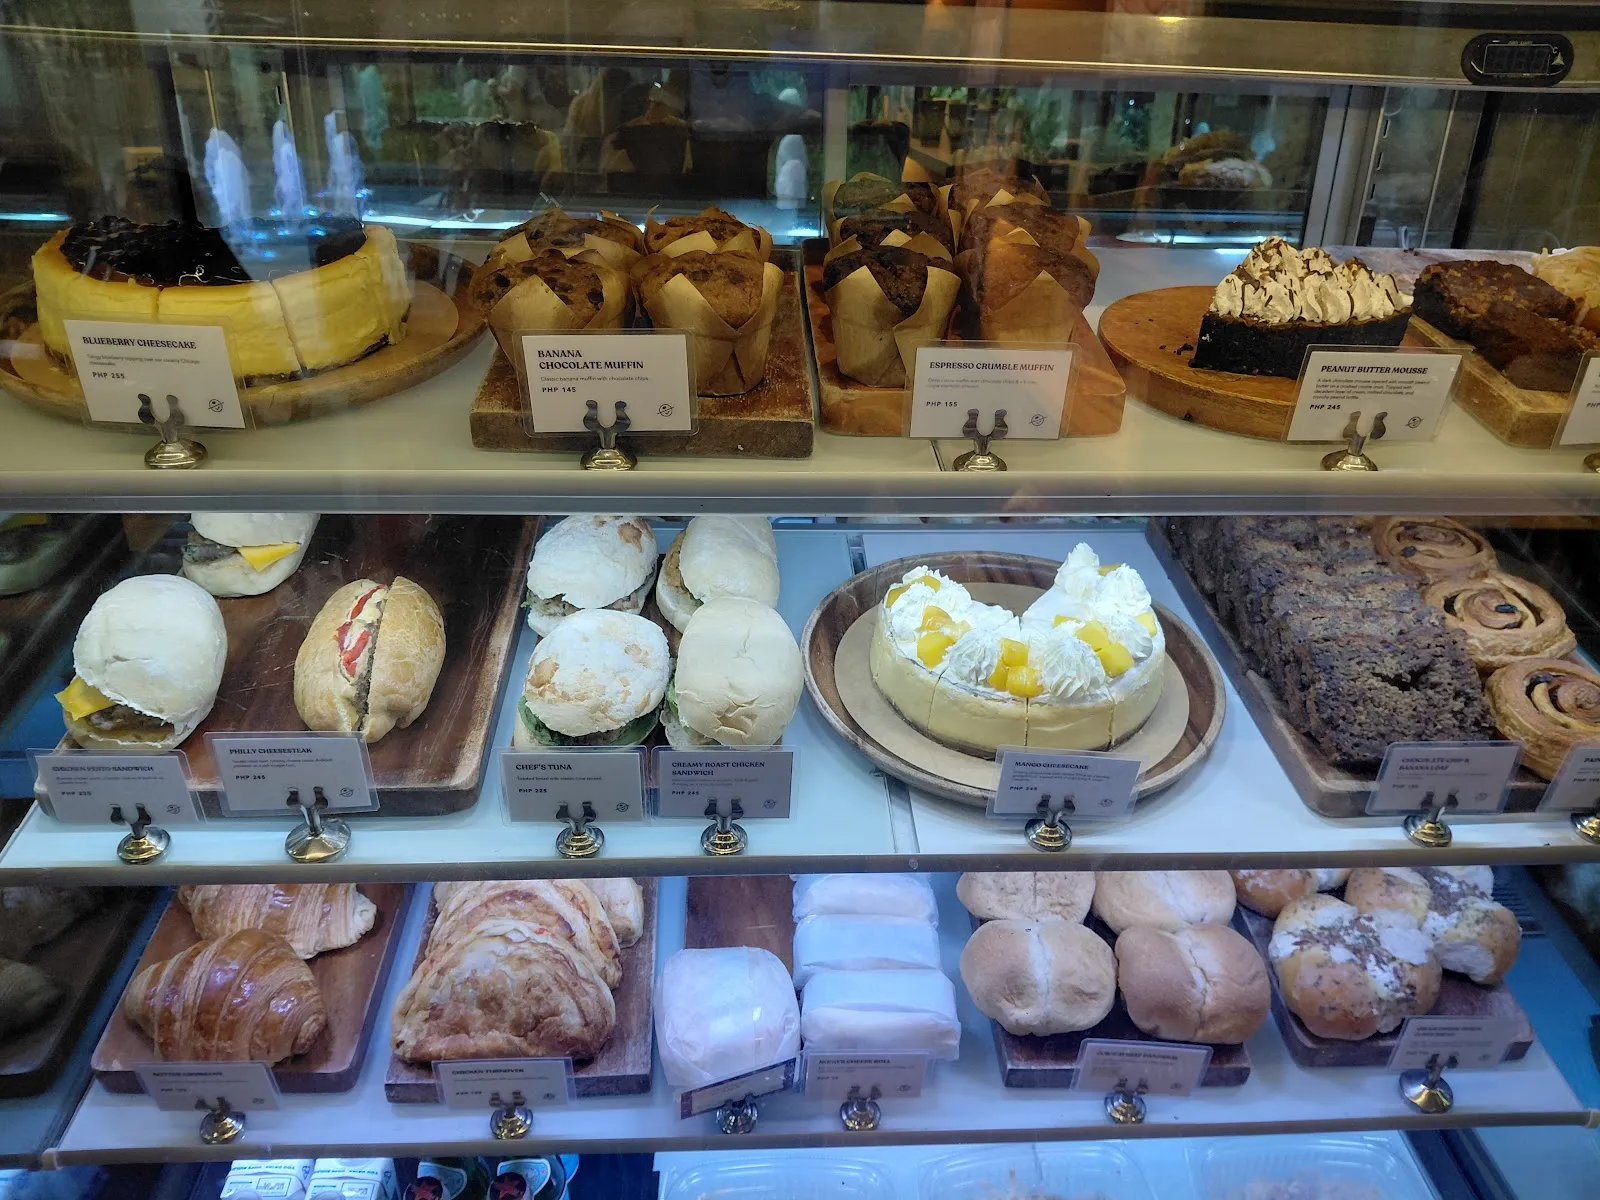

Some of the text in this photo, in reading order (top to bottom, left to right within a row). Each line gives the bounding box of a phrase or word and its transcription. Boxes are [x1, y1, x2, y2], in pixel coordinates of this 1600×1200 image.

[82, 336, 196, 349] BLUEBERRY CHEESECAKE
[538, 350, 582, 358] BANANA
[539, 361, 644, 370] CHOCOLATE MUFFIN
[929, 361, 974, 370] ESPRESSO
[976, 362, 1018, 371] CRUMBLE
[1320, 365, 1356, 373] PEANUT
[1357, 366, 1391, 374] BUTTER
[1042, 762, 1089, 770] CHEESECAKE
